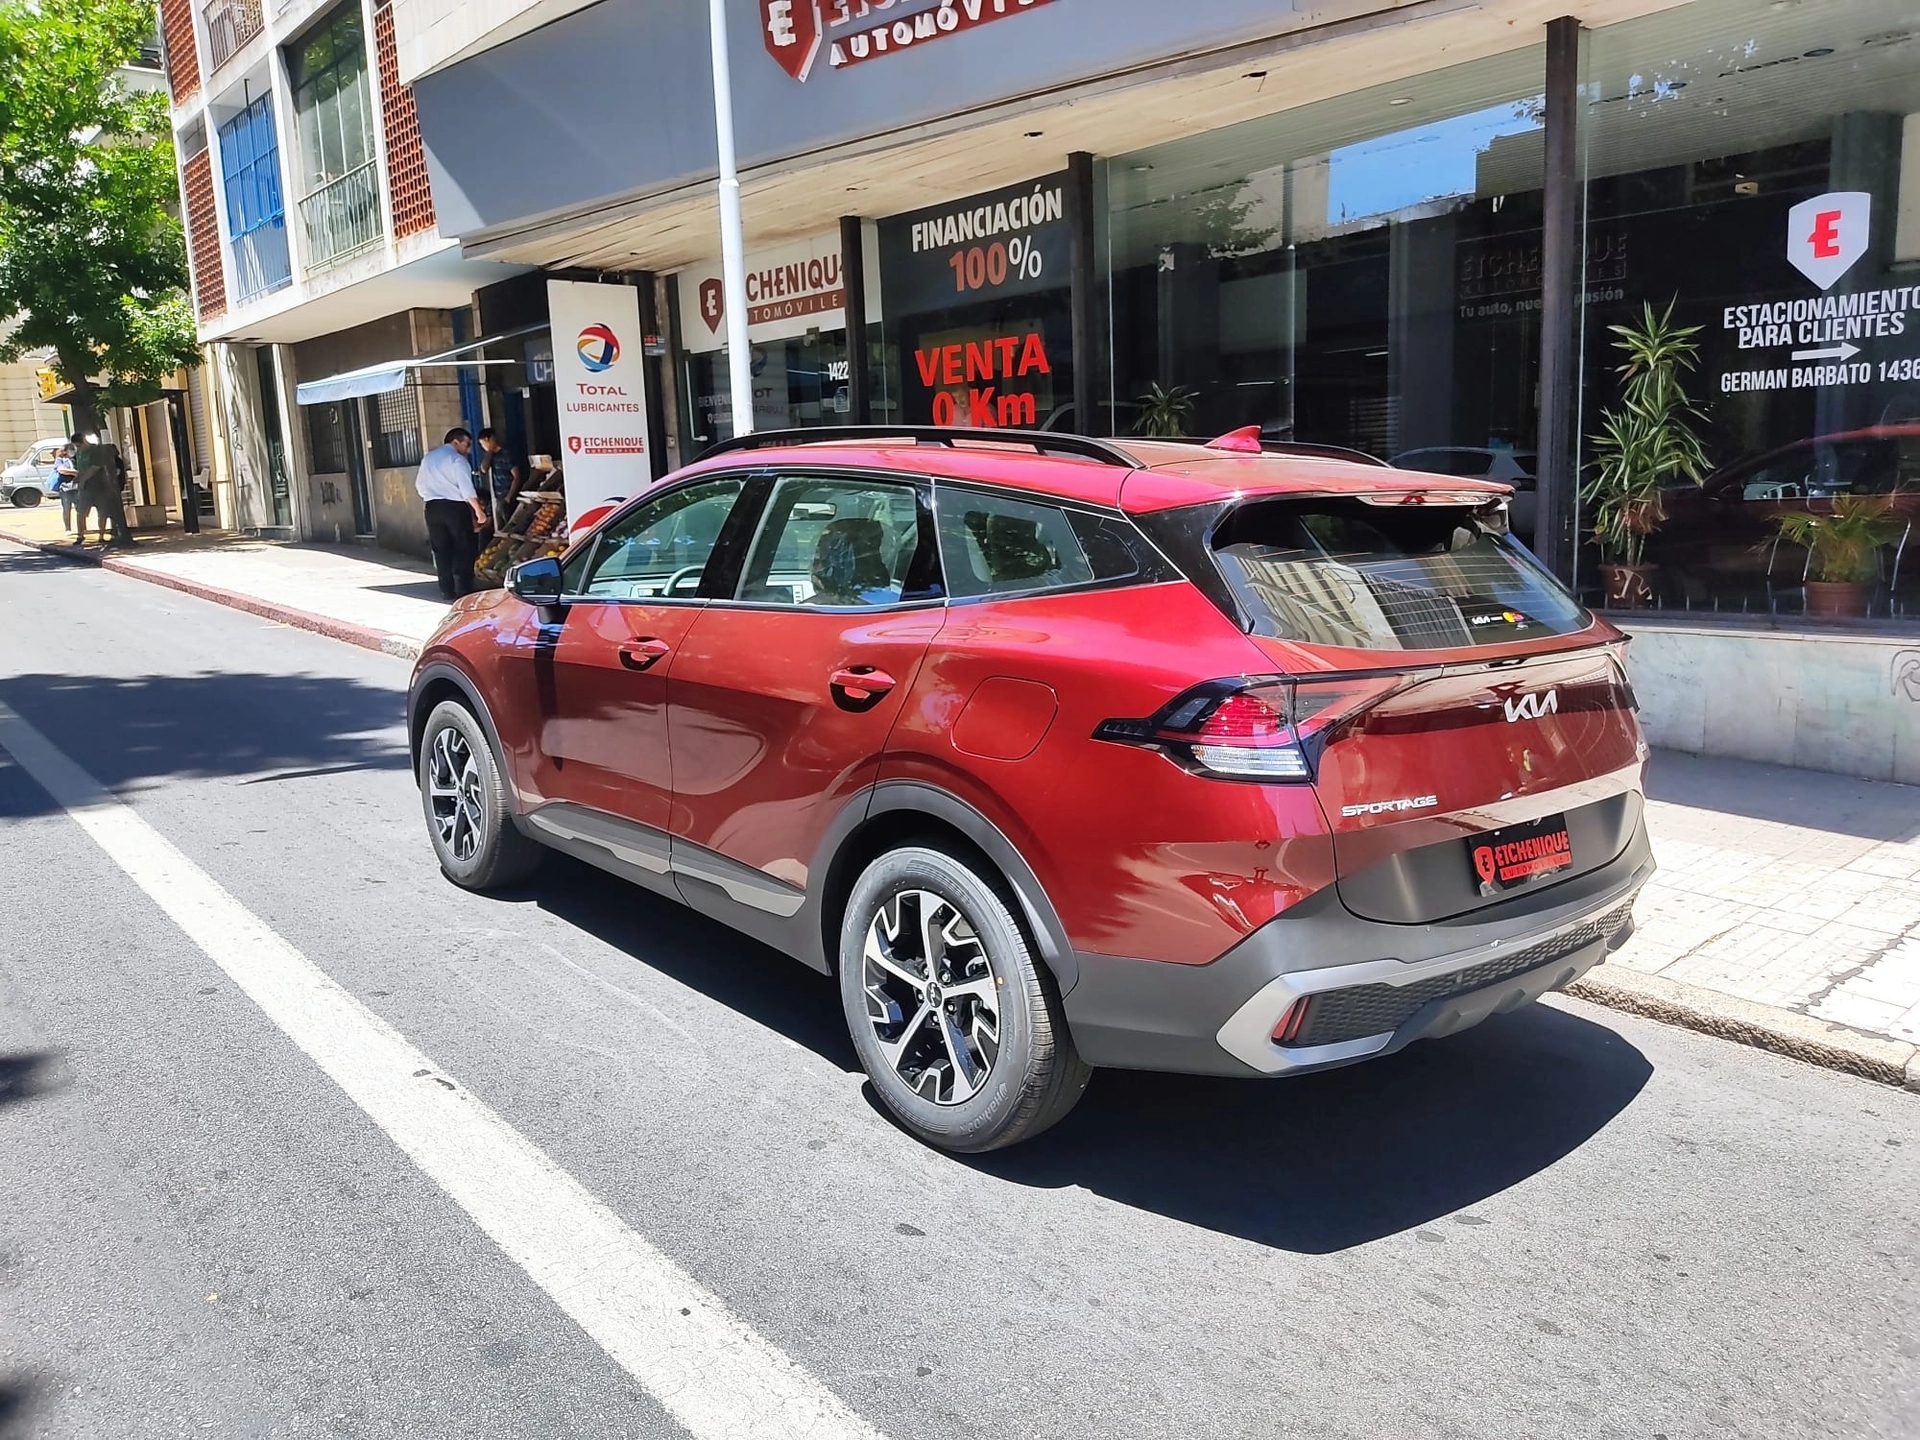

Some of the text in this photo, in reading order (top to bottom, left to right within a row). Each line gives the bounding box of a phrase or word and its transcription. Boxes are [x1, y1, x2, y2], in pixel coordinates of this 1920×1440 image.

[911, 184, 1062, 252] FINANCIACIÓN
[950, 235, 1042, 291] 100%
[1738, 311, 1905, 348] PARA CLIENTES
[827, 361, 849, 381] 1422
[915, 333, 1049, 387] VENTA
[1721, 358, 1920, 392] GERMAN BARBATO 1436
[576, 383, 627, 395] TOTAL
[567, 403, 640, 413] LUBRICANTES
[969, 387, 1036, 428] Km
[584, 437, 644, 447] ETCHENIQUE
[1504, 690, 1558, 723] KIA
[1342, 795, 1438, 817] SPORTAGE
[1495, 830, 1569, 866] ETCHENIQUE
